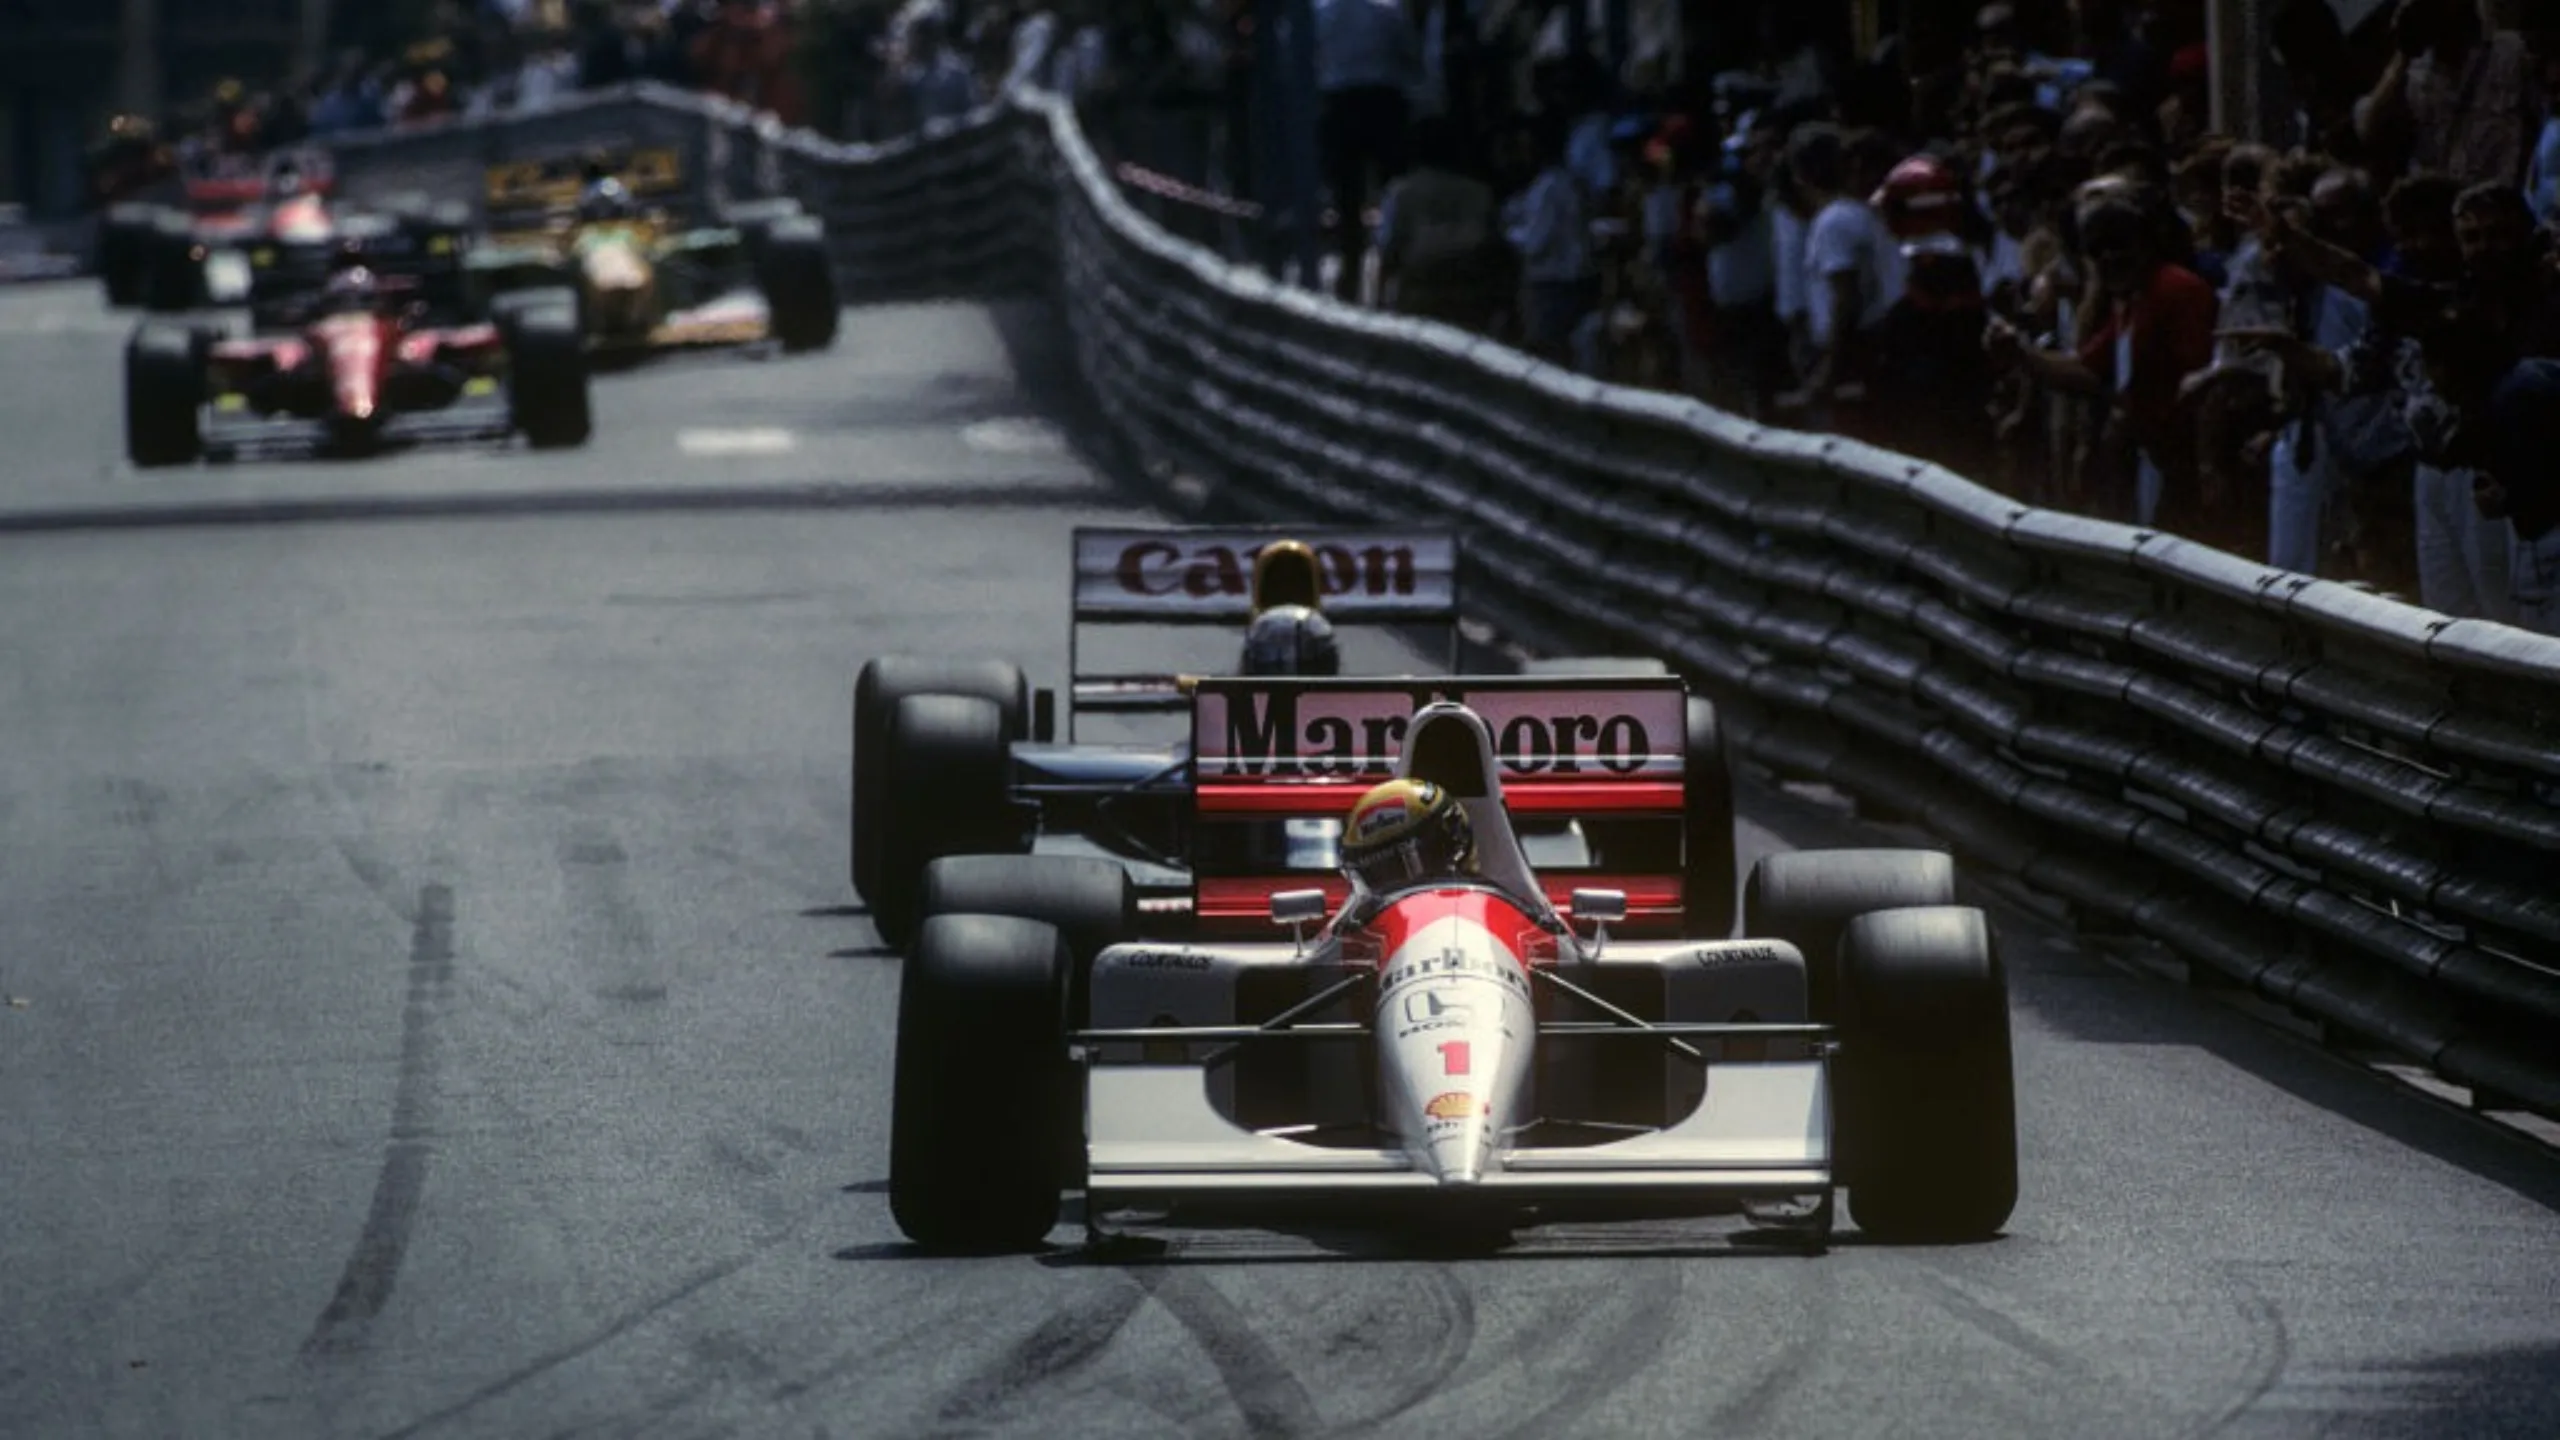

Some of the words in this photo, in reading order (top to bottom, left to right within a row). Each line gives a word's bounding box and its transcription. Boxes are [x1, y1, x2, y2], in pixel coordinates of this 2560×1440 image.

[1117, 540, 1415, 597] Caon
[1223, 688, 1650, 776] Maroro
[1436, 1041, 1470, 1075] 1
